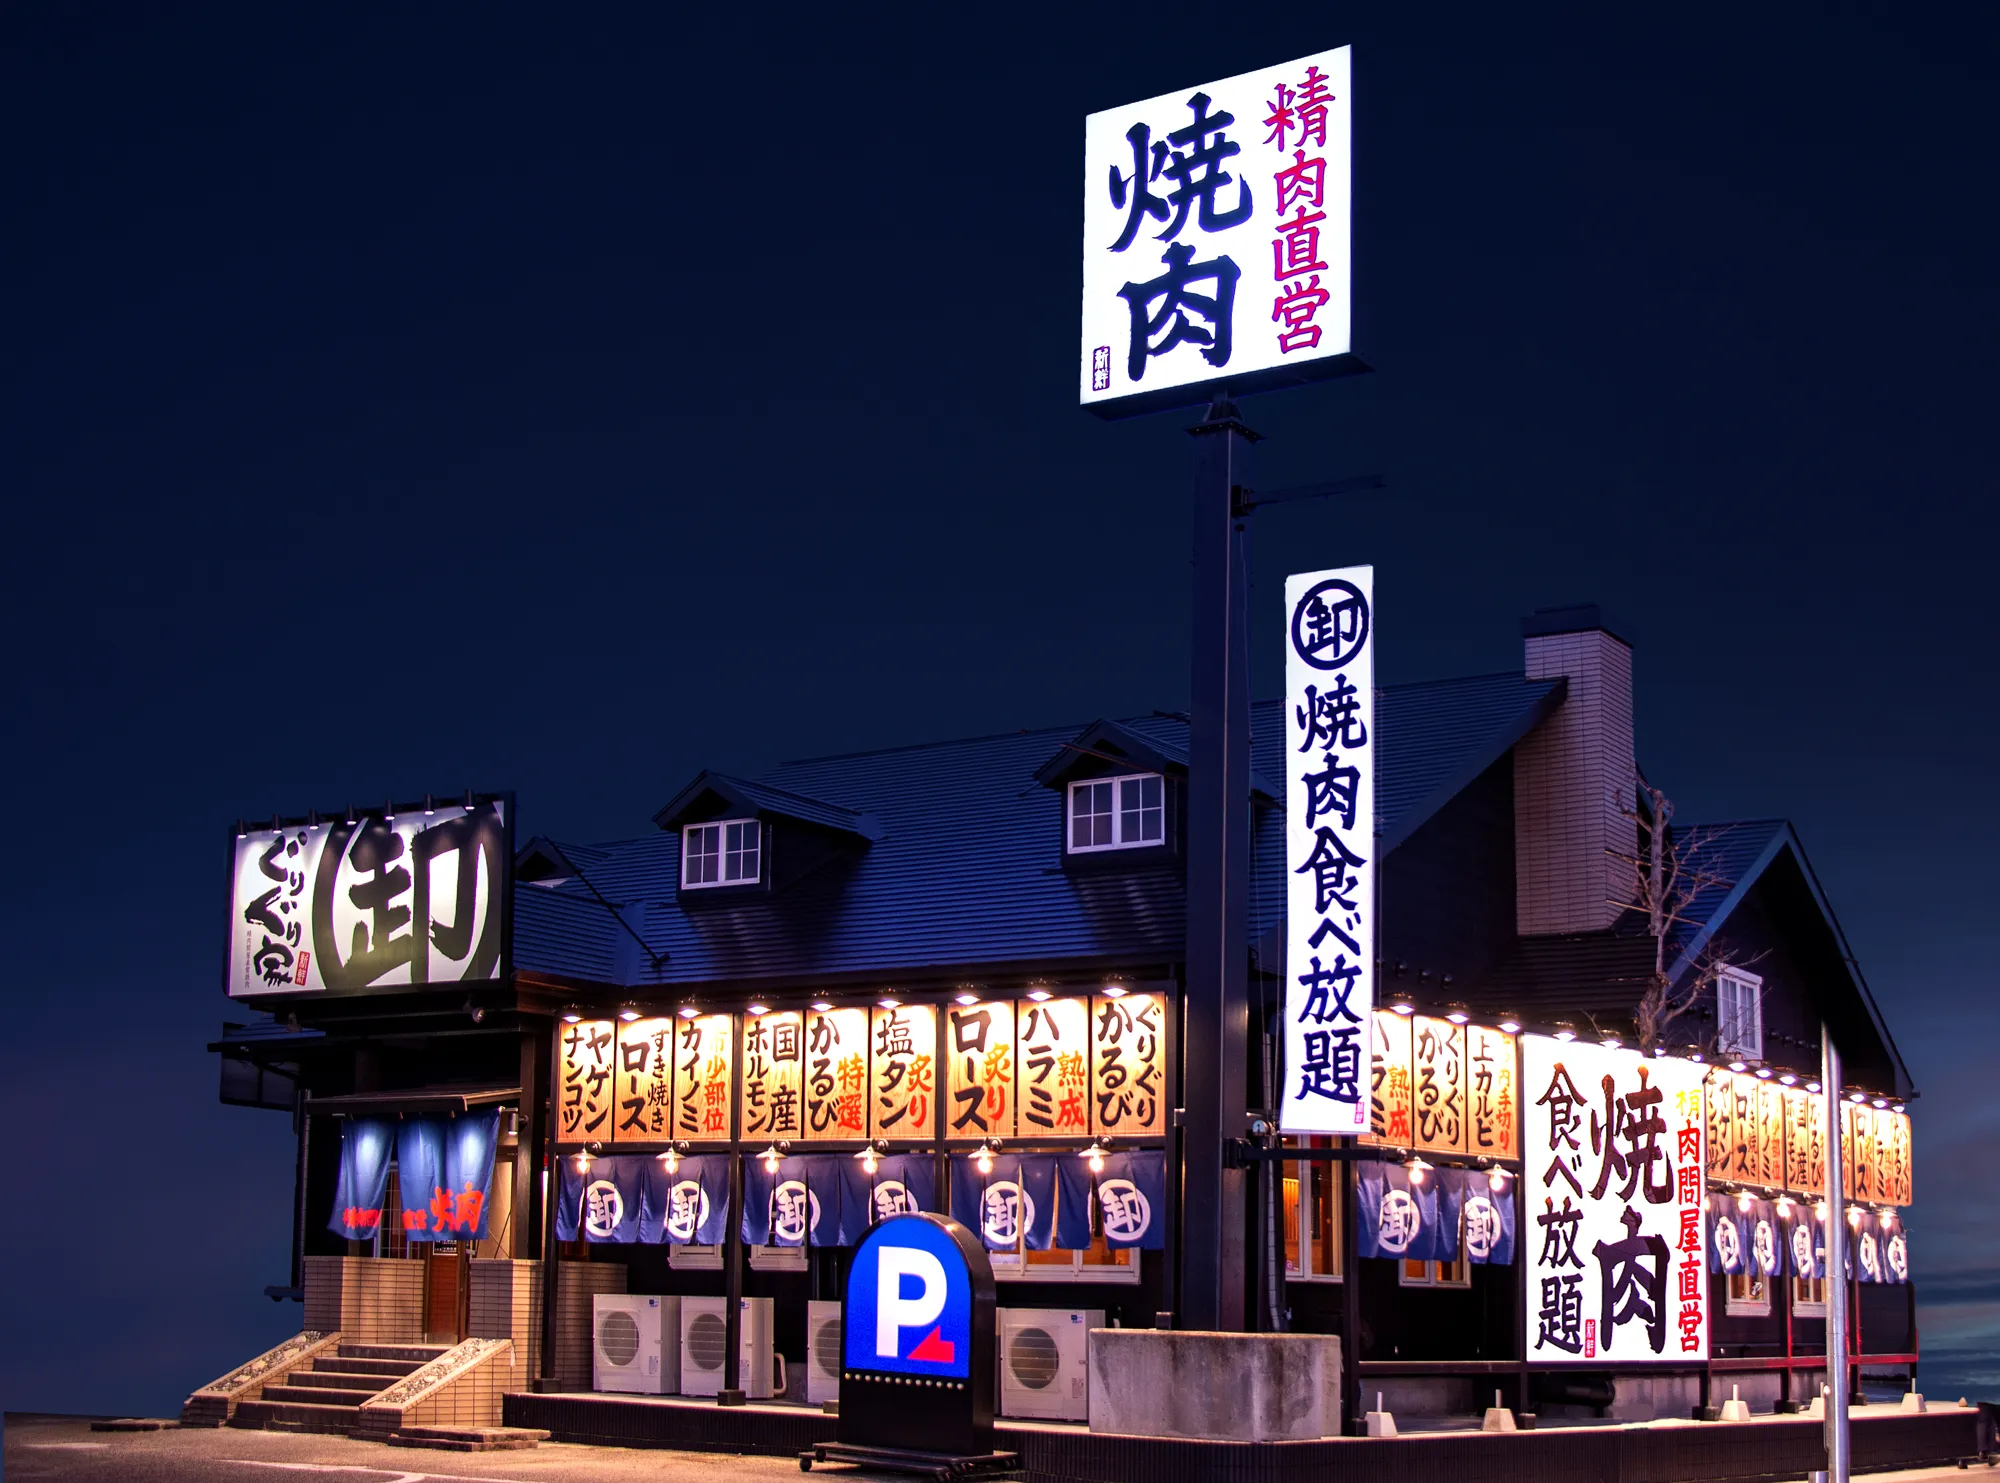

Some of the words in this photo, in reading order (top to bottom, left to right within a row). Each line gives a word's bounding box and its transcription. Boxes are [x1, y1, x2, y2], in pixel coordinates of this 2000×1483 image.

[1106, 91, 1253, 382] 焼肉
[1262, 66, 1336, 354] 精肉直営
[1298, 592, 1363, 660] 卸
[1294, 673, 1367, 1104] 焼肉食べ放題
[563, 1027, 584, 1134] ナンコツ
[585, 1027, 612, 1131] ヤゲン
[619, 1041, 650, 1133] ロース
[648, 1029, 669, 1133] すき焼き
[679, 1020, 702, 1133] カイノミ
[746, 1020, 770, 1134] ホルモン
[769, 1022, 800, 1133] 国産
[808, 1016, 840, 1132] かるび
[837, 1053, 865, 1130] 特選
[876, 1010, 915, 1130] 塩タン
[906, 1054, 932, 1128] 炙り
[950, 1010, 992, 1132] ロース
[984, 1042, 1011, 1121] 炙り
[1021, 1008, 1059, 1128] ハラミ
[1056, 1051, 1086, 1129] 熟成
[1097, 1001, 1134, 1127] かるび
[1135, 1001, 1163, 1127] ぐりぐり
[1387, 1064, 1410, 1139] 熟成
[1418, 1027, 1444, 1142] かるび
[1444, 1027, 1463, 1145] ぐりぐり
[1473, 1035, 1494, 1147] 上カルビ
[1735, 1092, 1750, 1177] ロース
[1855, 1112, 1868, 1197] ロース
[1534, 1062, 1587, 1355] 食べ放題
[1587, 1065, 1674, 1354] 焼肉
[876, 1246, 947, 1358] P
